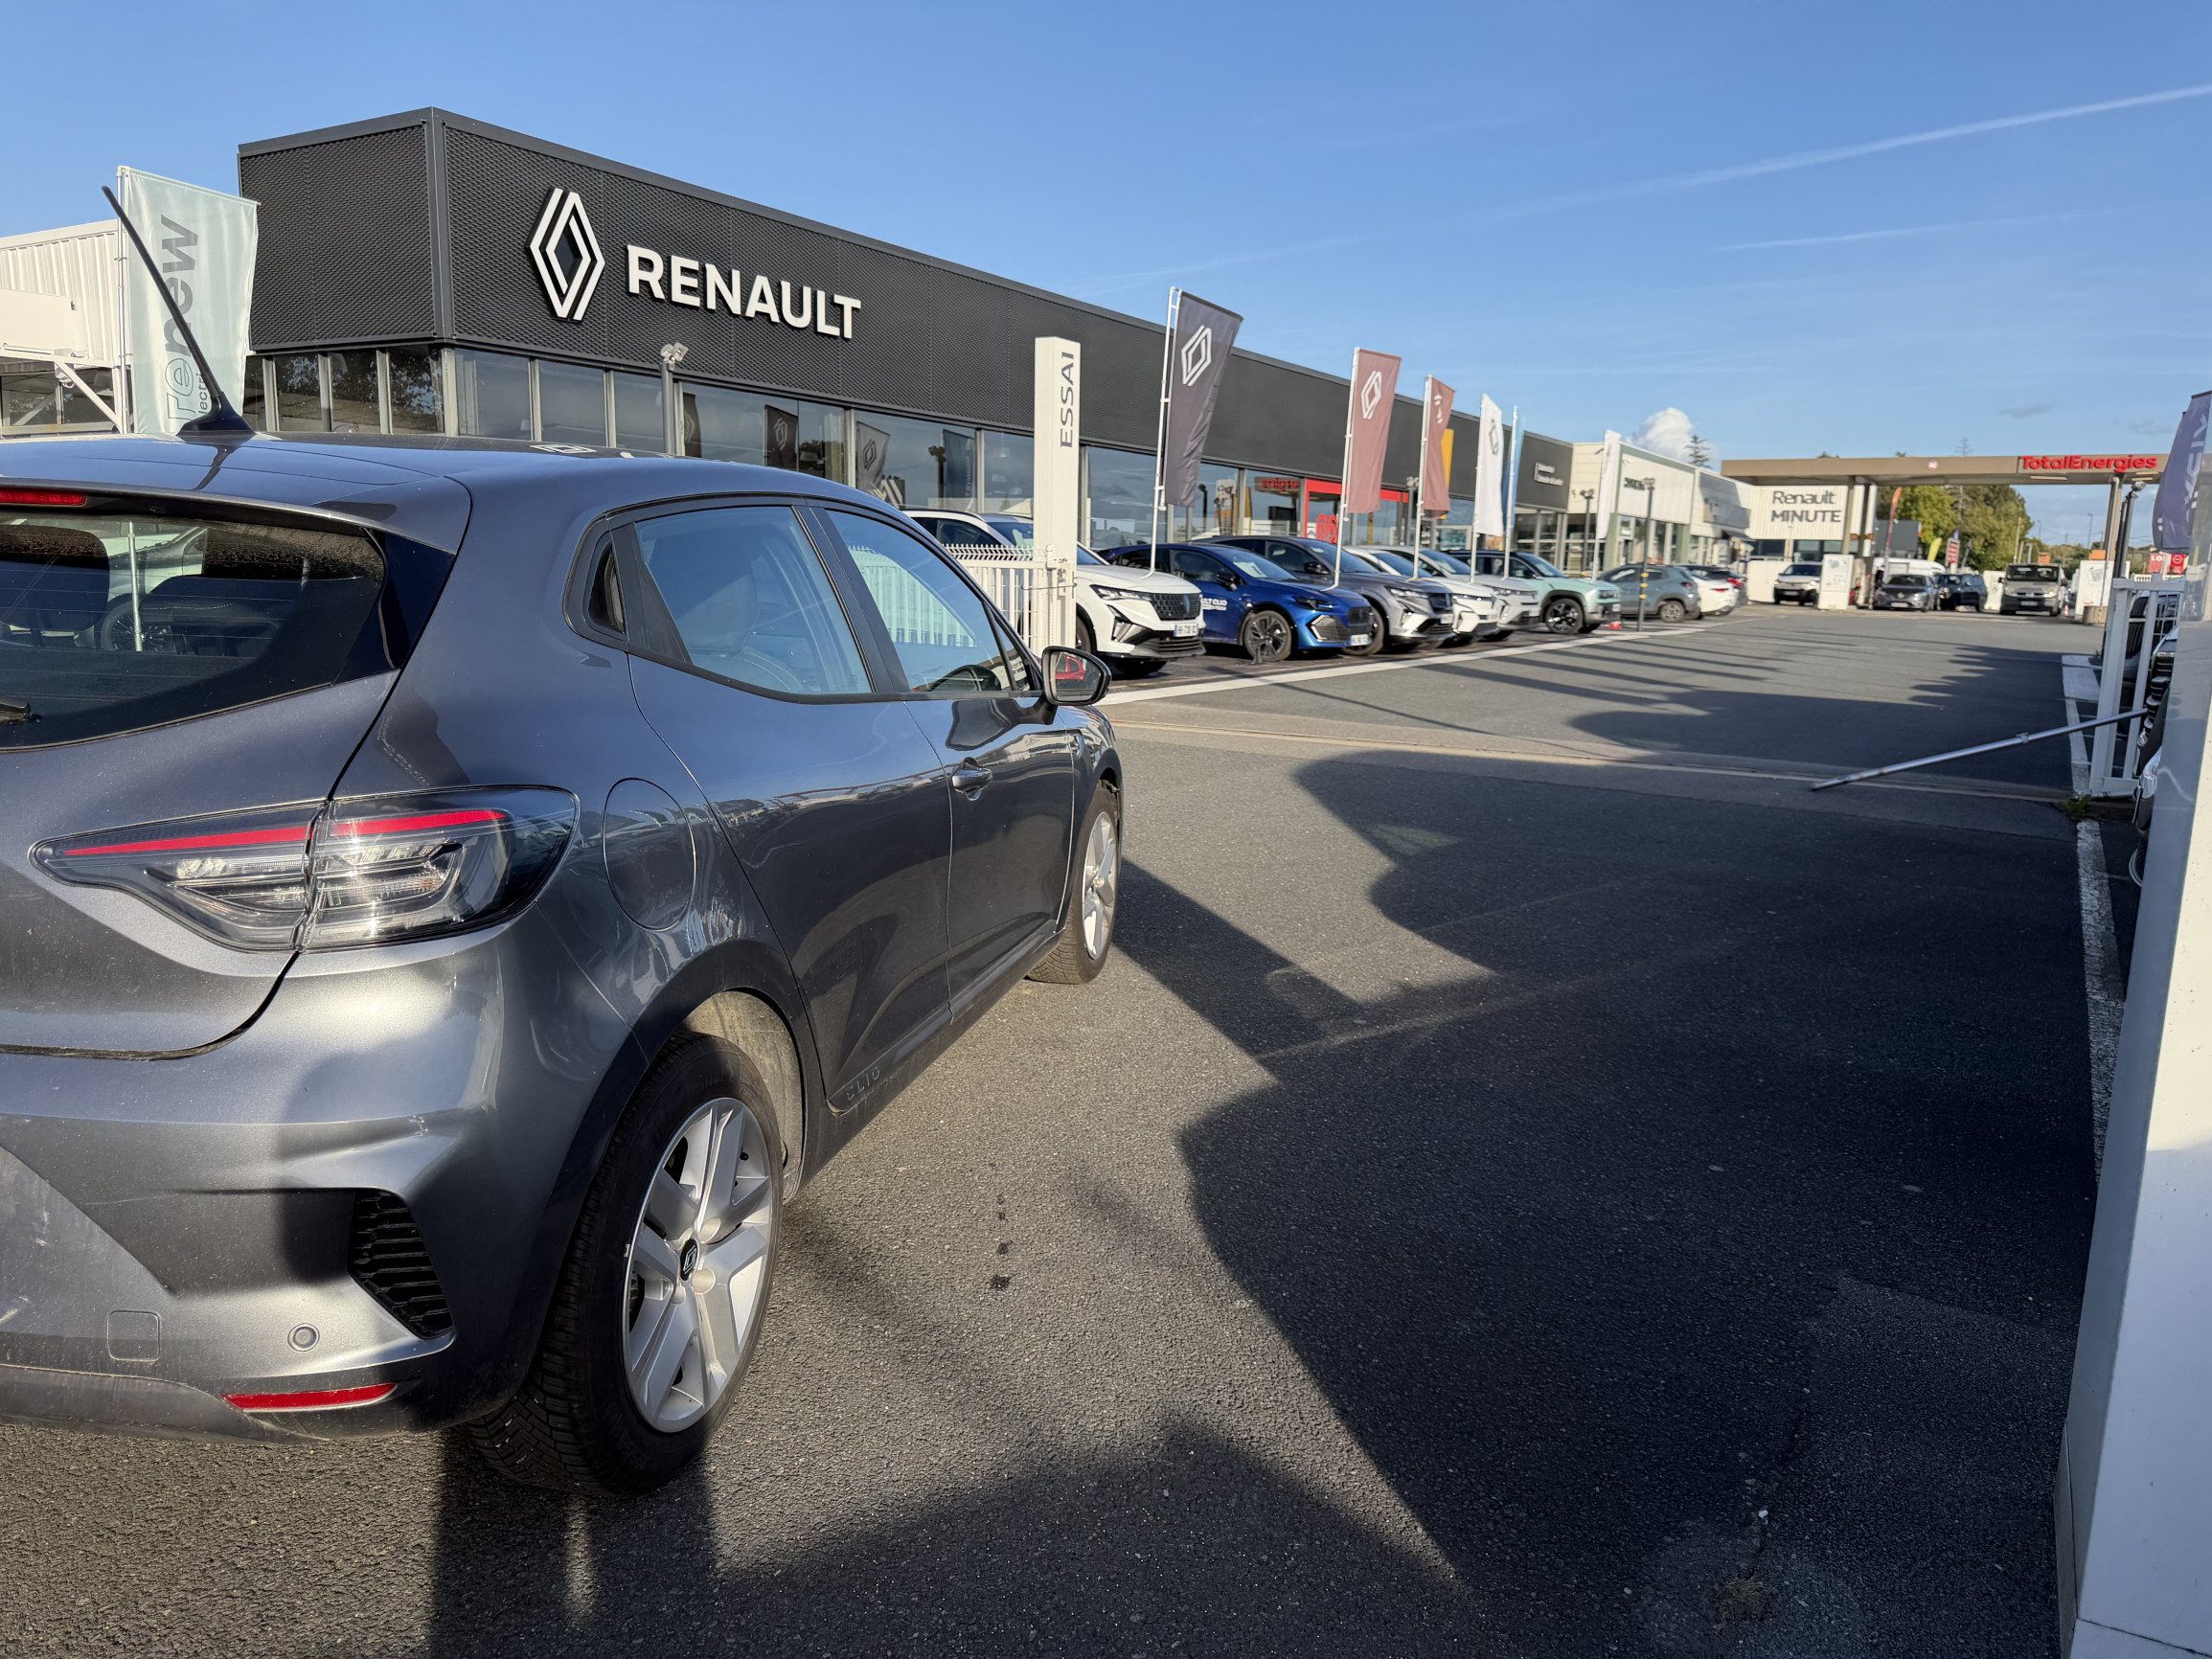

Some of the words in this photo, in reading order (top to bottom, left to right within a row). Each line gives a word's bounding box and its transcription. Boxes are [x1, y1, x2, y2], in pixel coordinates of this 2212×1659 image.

[627, 244, 861, 339] RENAULT
[1060, 351, 1074, 448] ESSAI
[2020, 454, 2158, 472] TotalEnergies
[1771, 490, 1836, 505] Renault
[1770, 510, 1843, 523] MINUTE
[847, 1066, 880, 1101] CLIO
